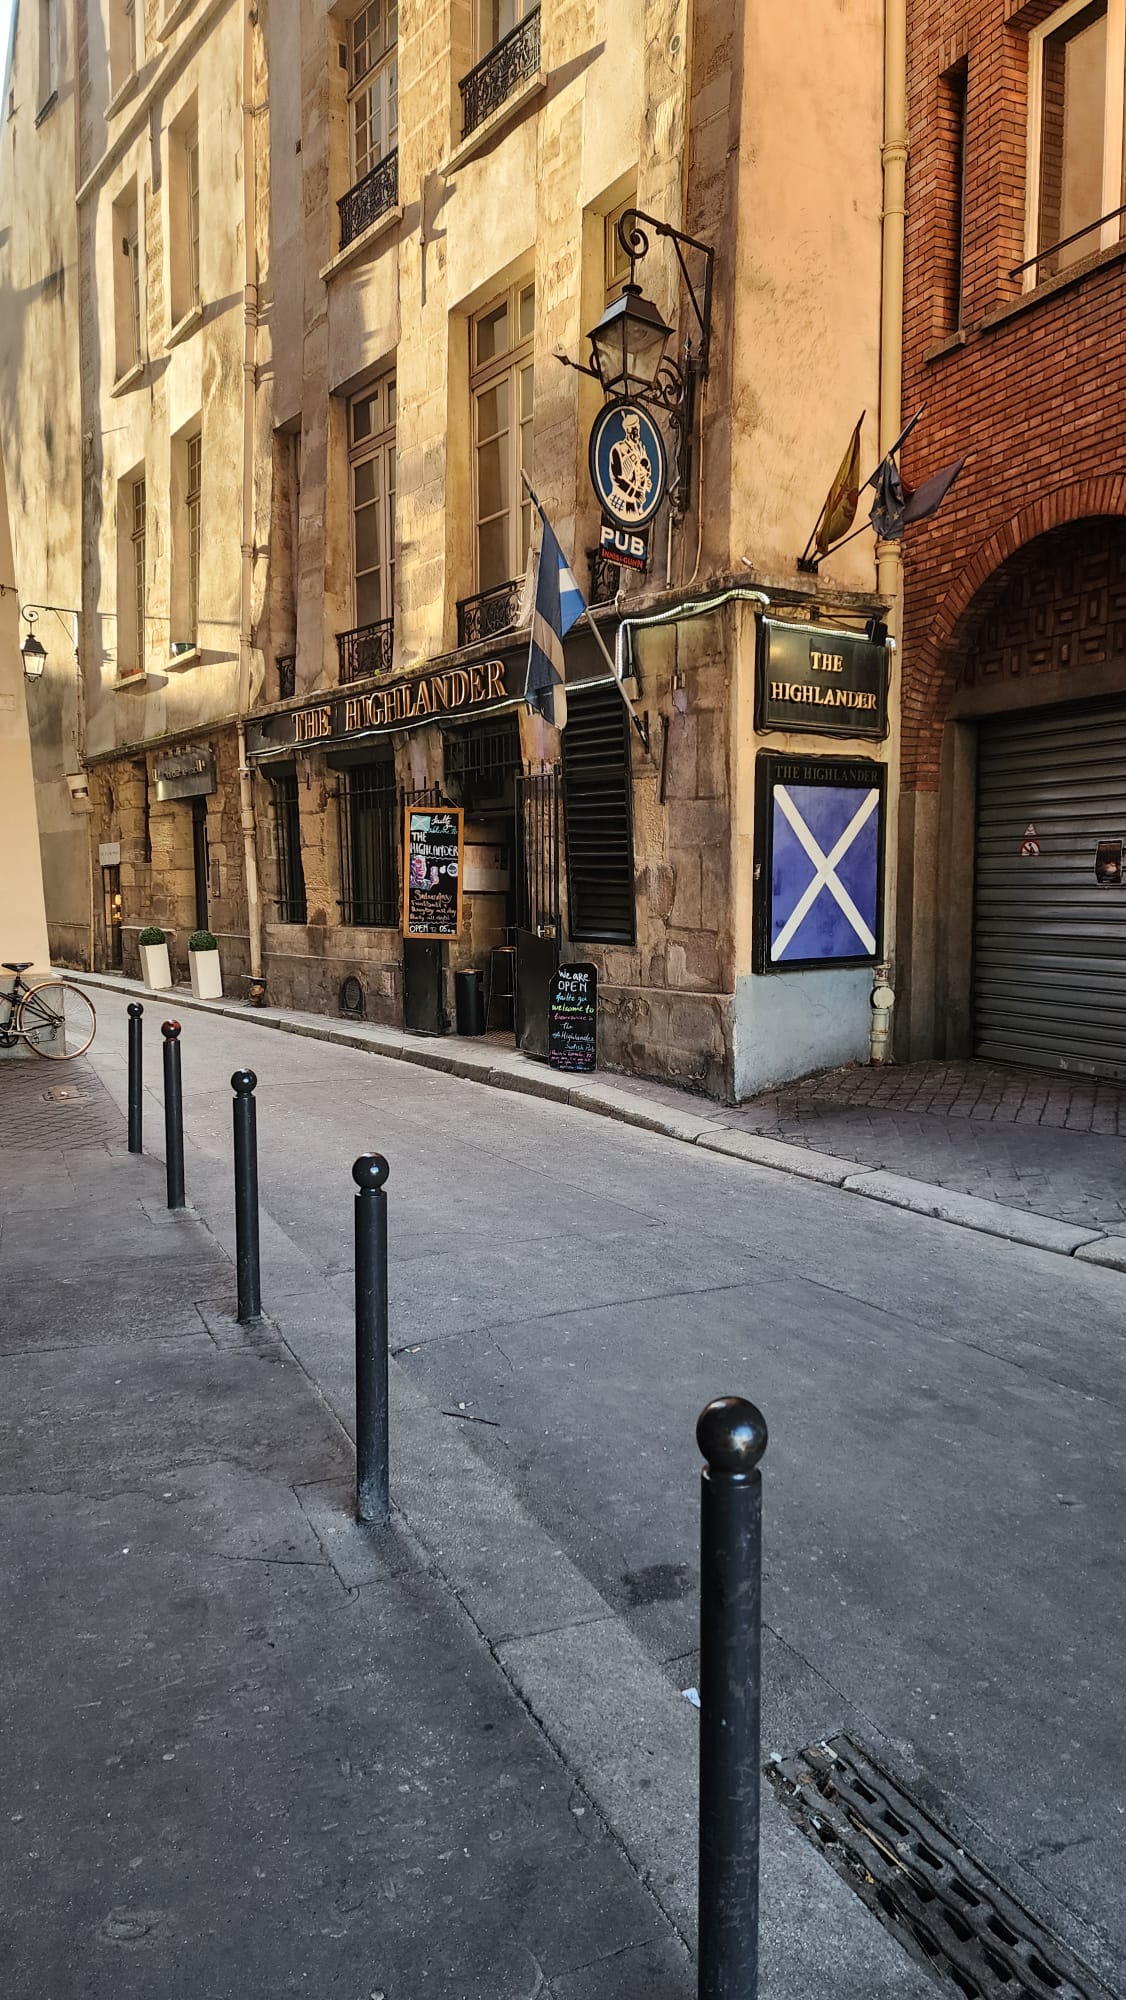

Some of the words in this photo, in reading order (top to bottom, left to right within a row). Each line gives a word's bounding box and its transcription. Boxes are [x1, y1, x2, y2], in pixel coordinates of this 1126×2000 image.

[600, 525, 644, 555] PUB
[810, 651, 843, 672] THE
[291, 704, 332, 742] THE
[344, 659, 508, 732] HIGHLANDER
[770, 682, 877, 710] HIGHLANDER
[775, 765, 799, 779] THE
[804, 767, 878, 782] HIGHLANDER
[411, 831, 427, 842] THE
[410, 842, 458, 857] HIGHLANDER
[414, 889, 452, 903] Saturday
[409, 924, 428, 933] OPEN
[558, 968, 572, 980] We
[558, 980, 587, 992] OPEN
[551, 1002, 584, 1012] welcome
[585, 1004, 595, 1014] to
[561, 1031, 594, 1042] Highlander
